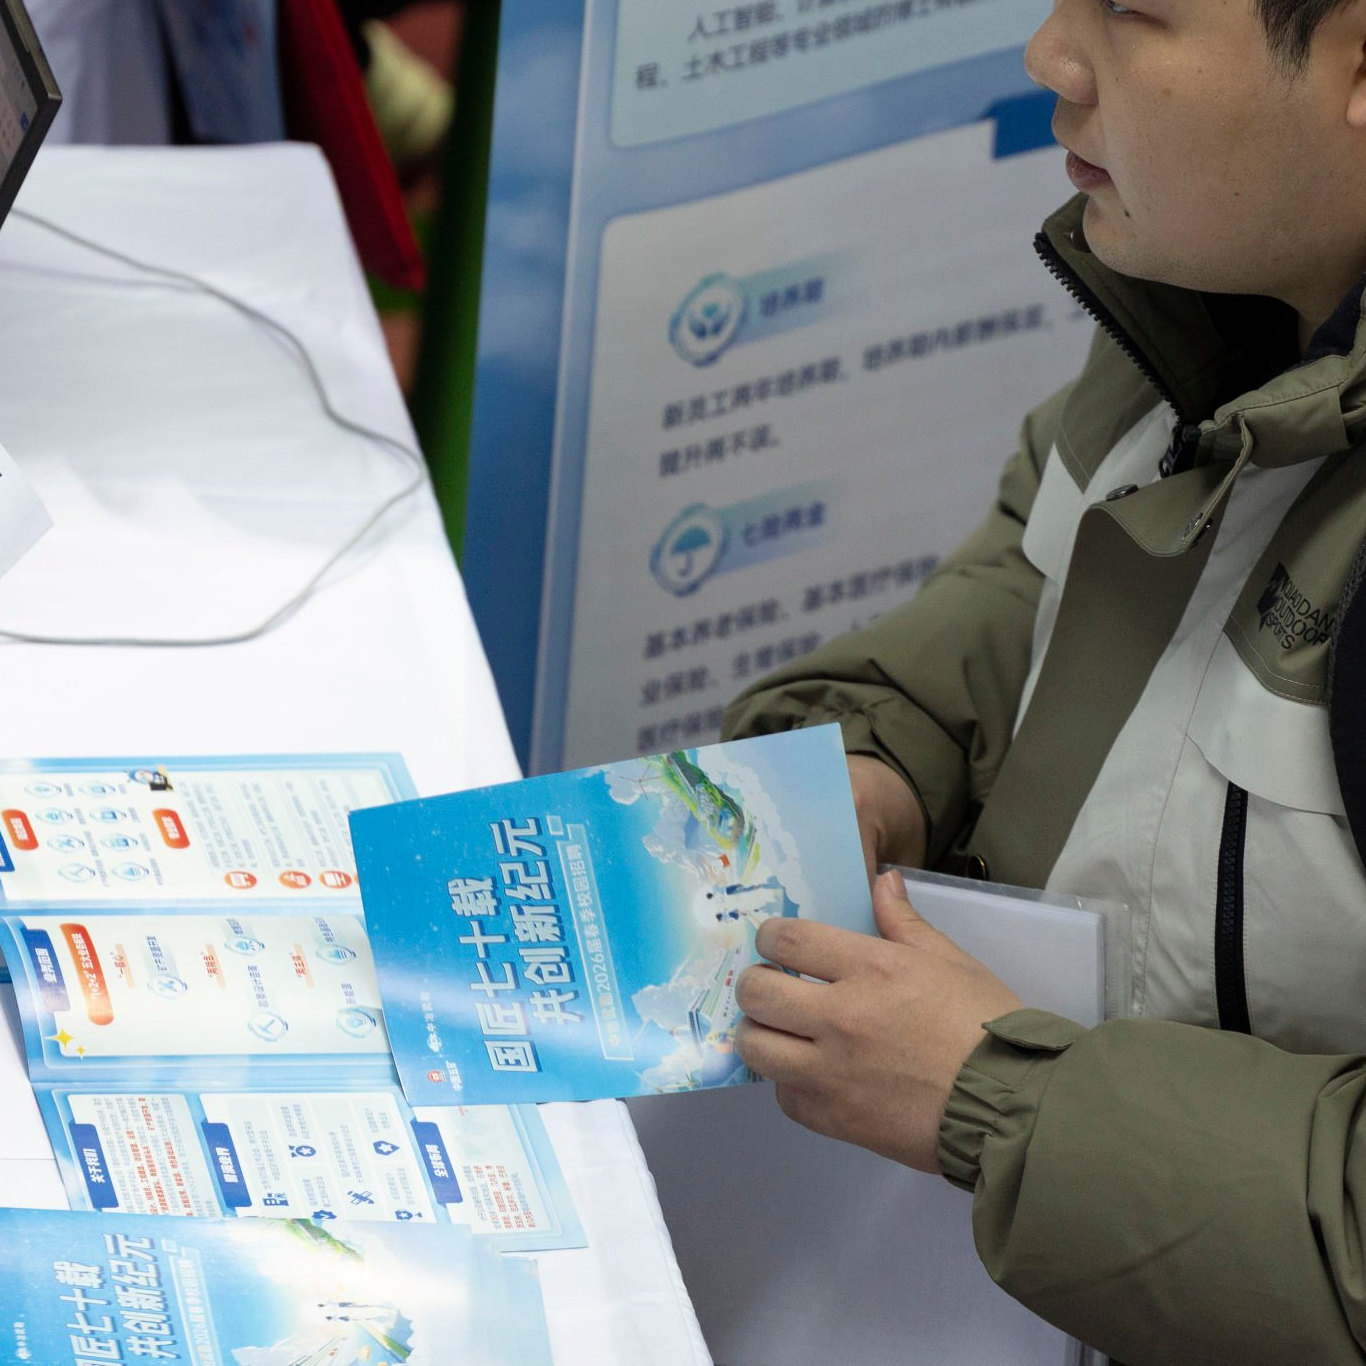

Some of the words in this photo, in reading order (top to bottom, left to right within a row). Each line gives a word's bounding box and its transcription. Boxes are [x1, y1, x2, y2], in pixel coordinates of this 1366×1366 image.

[447, 875, 543, 1074] 国匠七十载
[490, 815, 584, 1027] 共创新纪元
[103, 1233, 182, 1360] 共创新纪元
